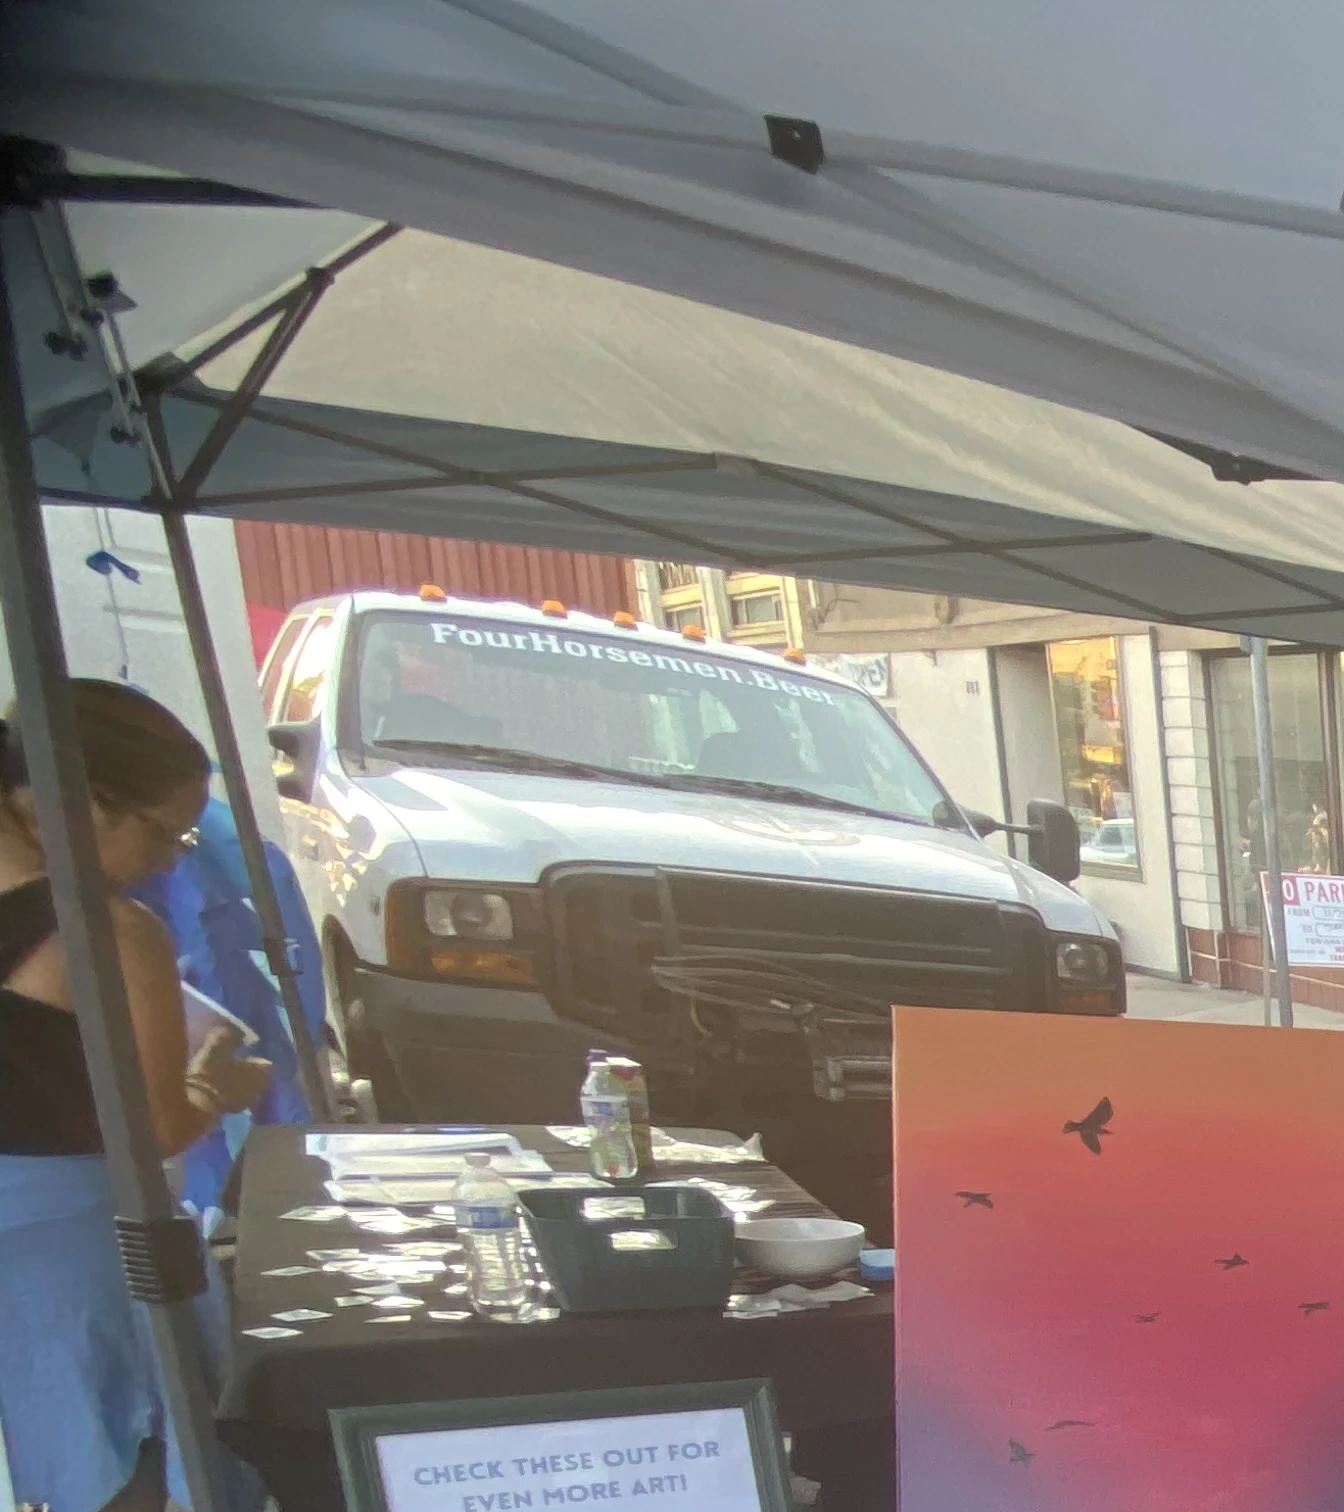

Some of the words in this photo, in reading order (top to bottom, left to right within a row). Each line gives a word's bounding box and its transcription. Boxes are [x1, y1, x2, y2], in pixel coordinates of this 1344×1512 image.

[432, 622, 836, 706] FourHorsemen.Beer
[413, 1458, 505, 1487] CHECK
[512, 1451, 594, 1476] THESE
[602, 1445, 659, 1469] OUT
[668, 1440, 721, 1462] FOR
[542, 1479, 622, 1506] MORE
[631, 1473, 688, 1496] ART!
